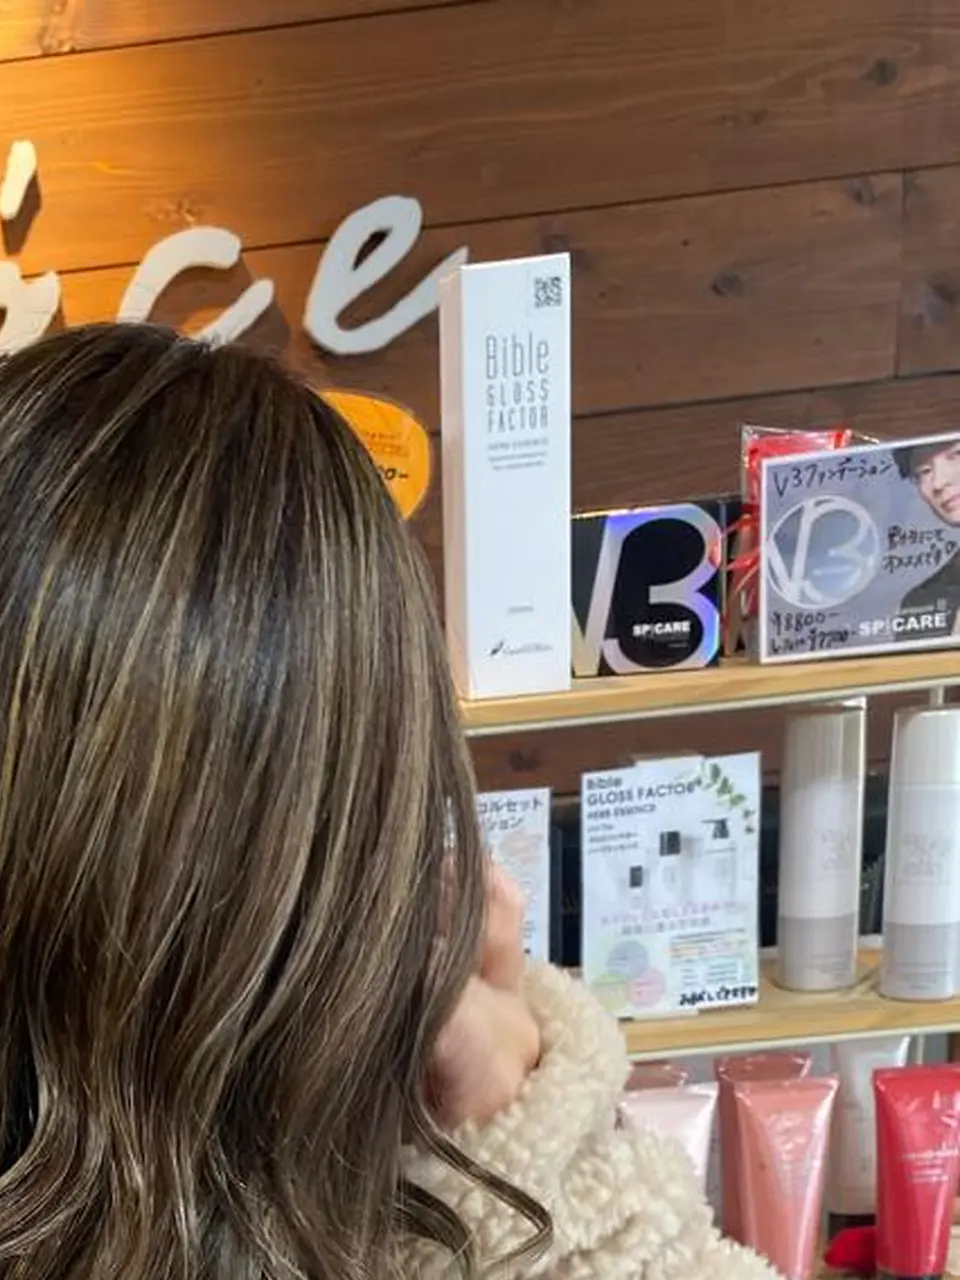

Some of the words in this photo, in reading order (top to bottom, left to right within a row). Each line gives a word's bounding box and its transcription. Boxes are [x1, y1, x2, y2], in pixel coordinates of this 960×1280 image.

[486, 331, 549, 380] Bible
[486, 378, 550, 407] GLOSS
[488, 405, 549, 433] FACTOR
[587, 789, 633, 806] GLOSS
